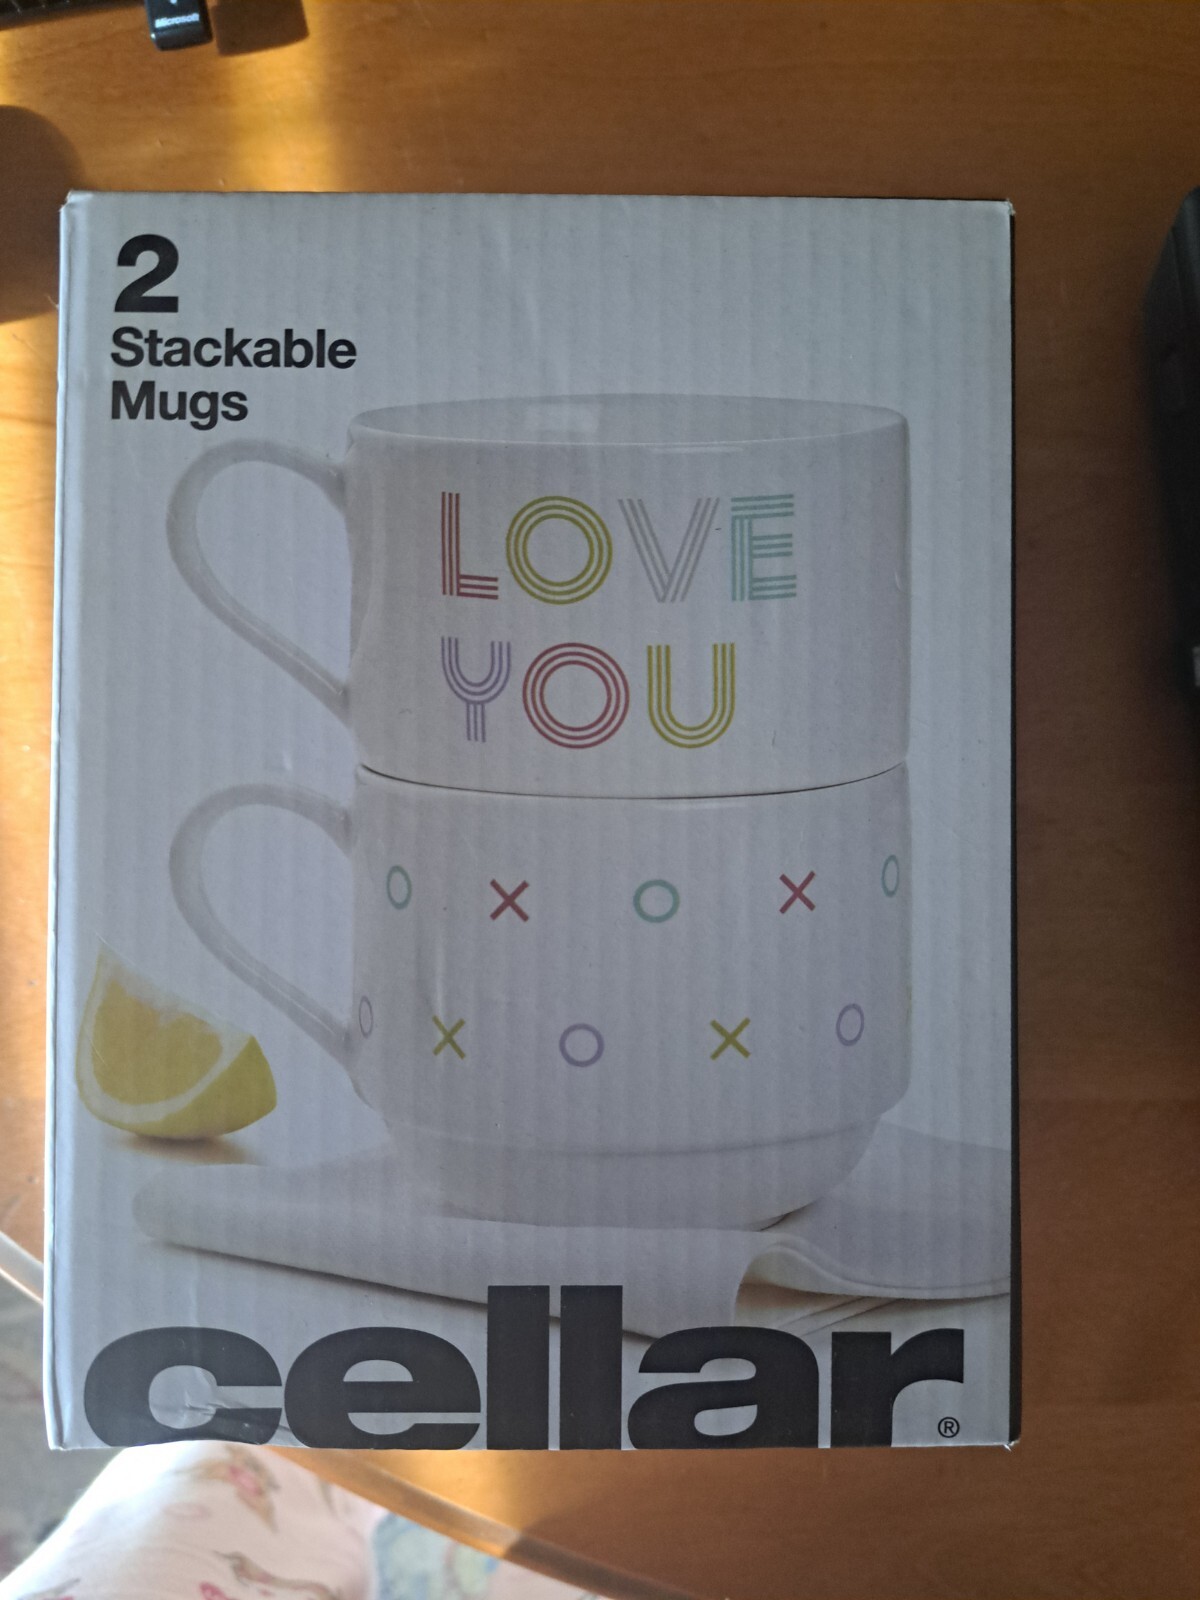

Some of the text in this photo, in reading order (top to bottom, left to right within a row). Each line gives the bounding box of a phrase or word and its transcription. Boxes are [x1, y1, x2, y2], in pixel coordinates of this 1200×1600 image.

[113, 233, 180, 314] 2
[110, 326, 358, 370] Stackable
[110, 380, 250, 432] Mugs
[441, 490, 798, 605] LOVE
[441, 635, 737, 750] YOU
[84, 1284, 964, 1450] cellar
